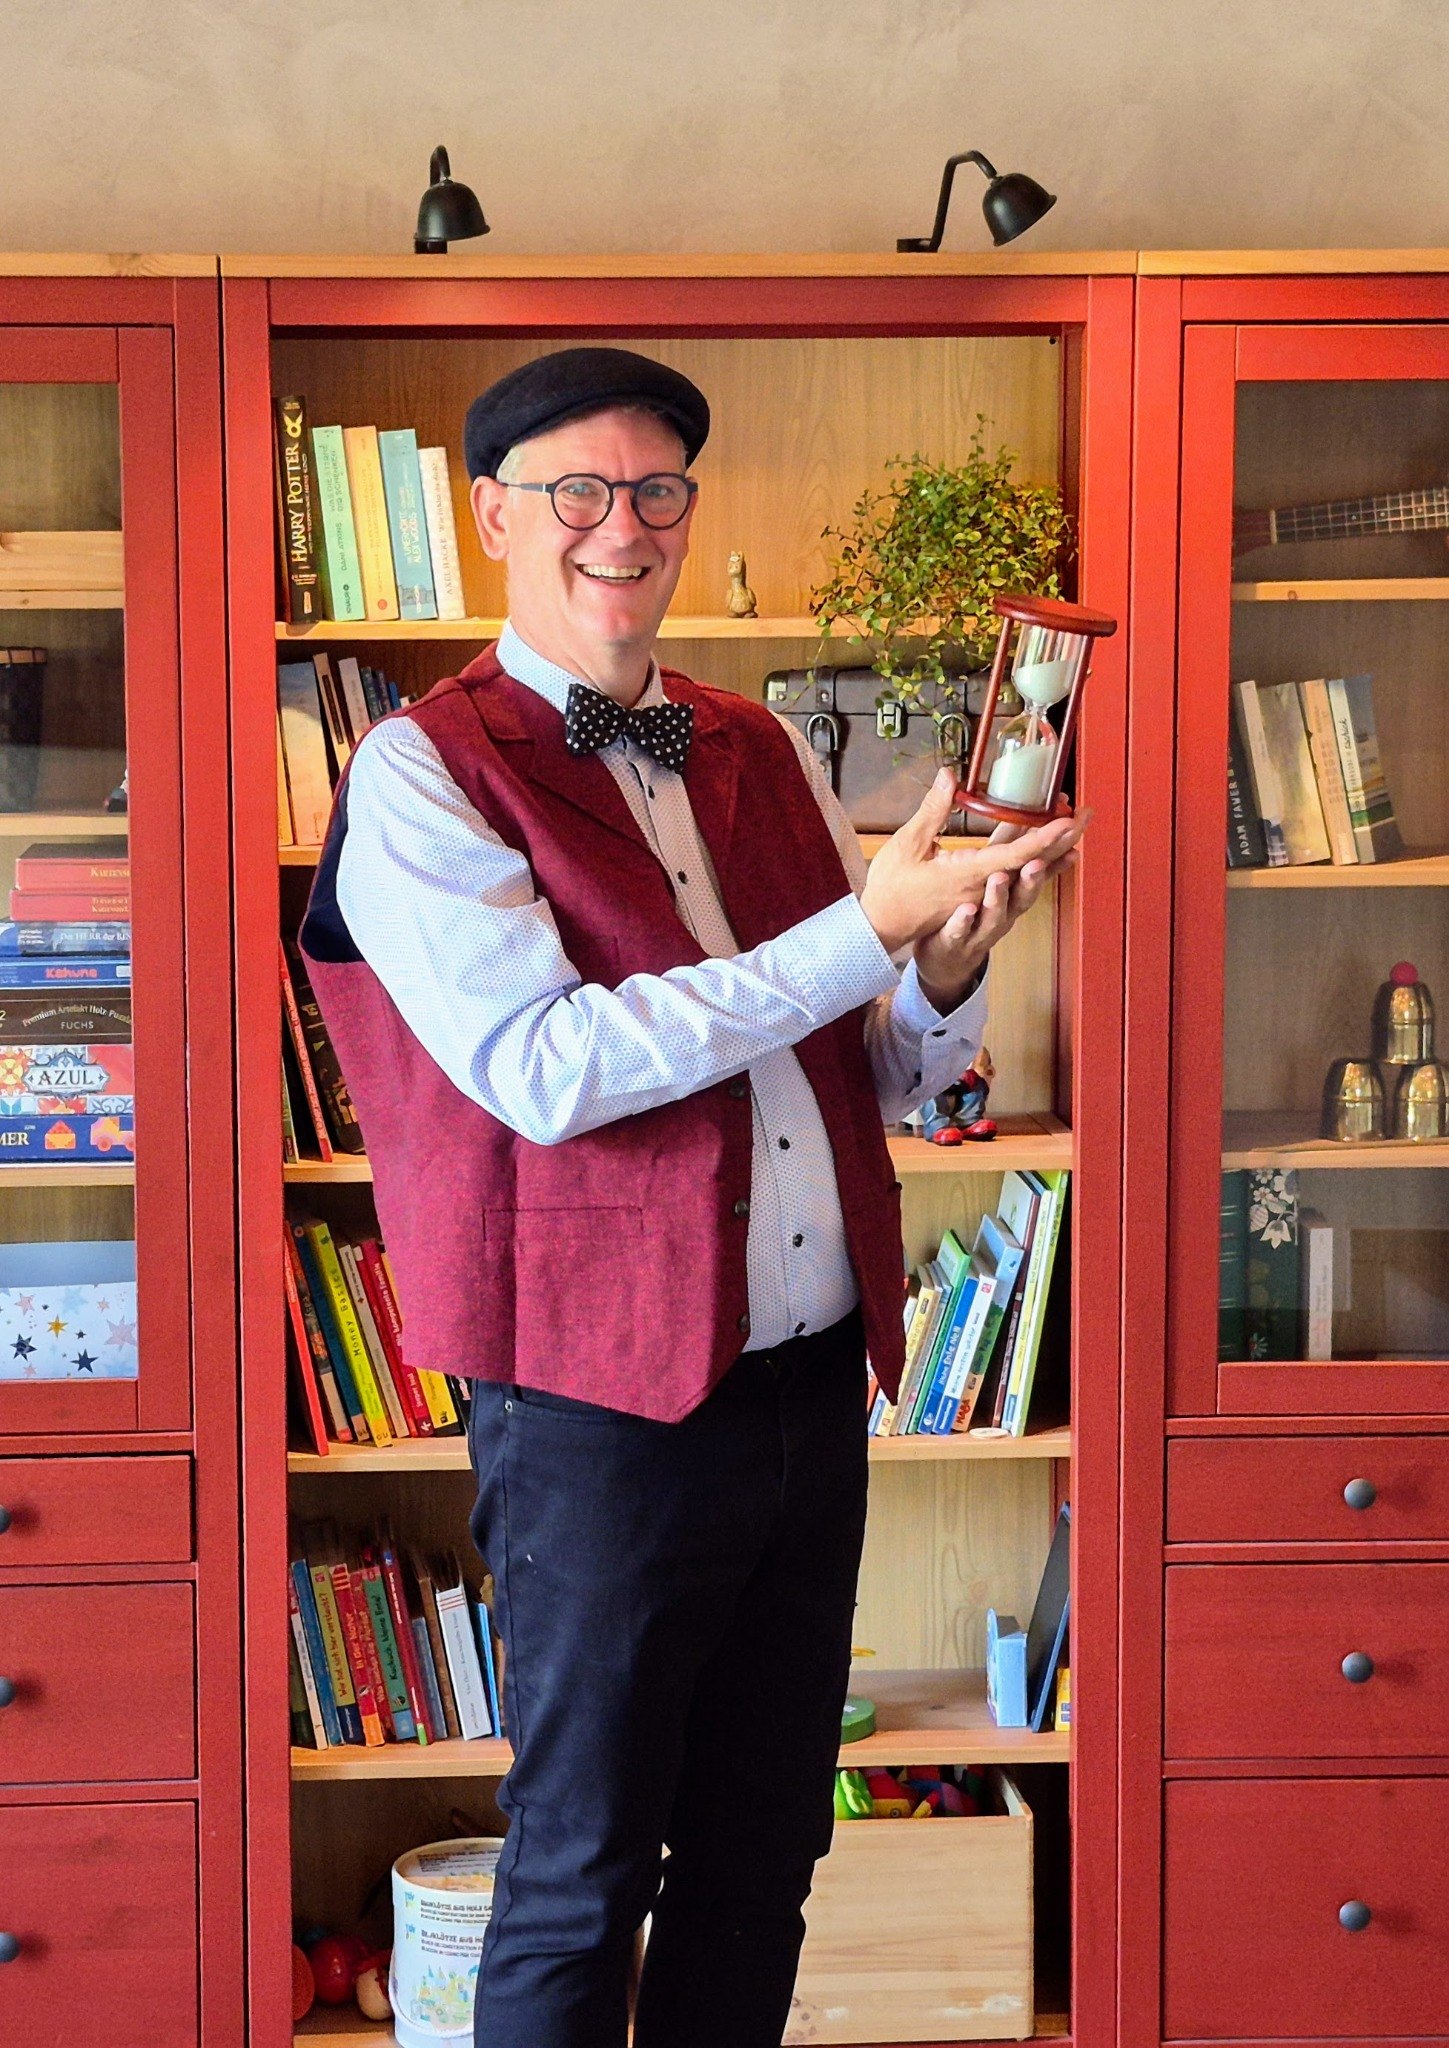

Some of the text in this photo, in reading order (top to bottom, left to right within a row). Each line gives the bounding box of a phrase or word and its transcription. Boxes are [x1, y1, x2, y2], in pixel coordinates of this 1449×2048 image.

[285, 442, 309, 562] HARRY POTTER
[335, 522, 344, 549] ATKINS
[441, 537, 453, 595] AXEL HACKE
[1238, 824, 1250, 855] ADAM
[22, 1009, 57, 1027] Premium
[61, 1020, 94, 1030] FUCHS
[38, 1069, 94, 1086] AZUL
[374, 1262, 387, 1288] Familie
[331, 1268, 348, 1311] Basics
[384, 1288, 400, 1333] kompetente
[955, 1397, 972, 1425] HABA
[345, 1611, 357, 1640] Natur
[375, 1684, 386, 1703] Was
